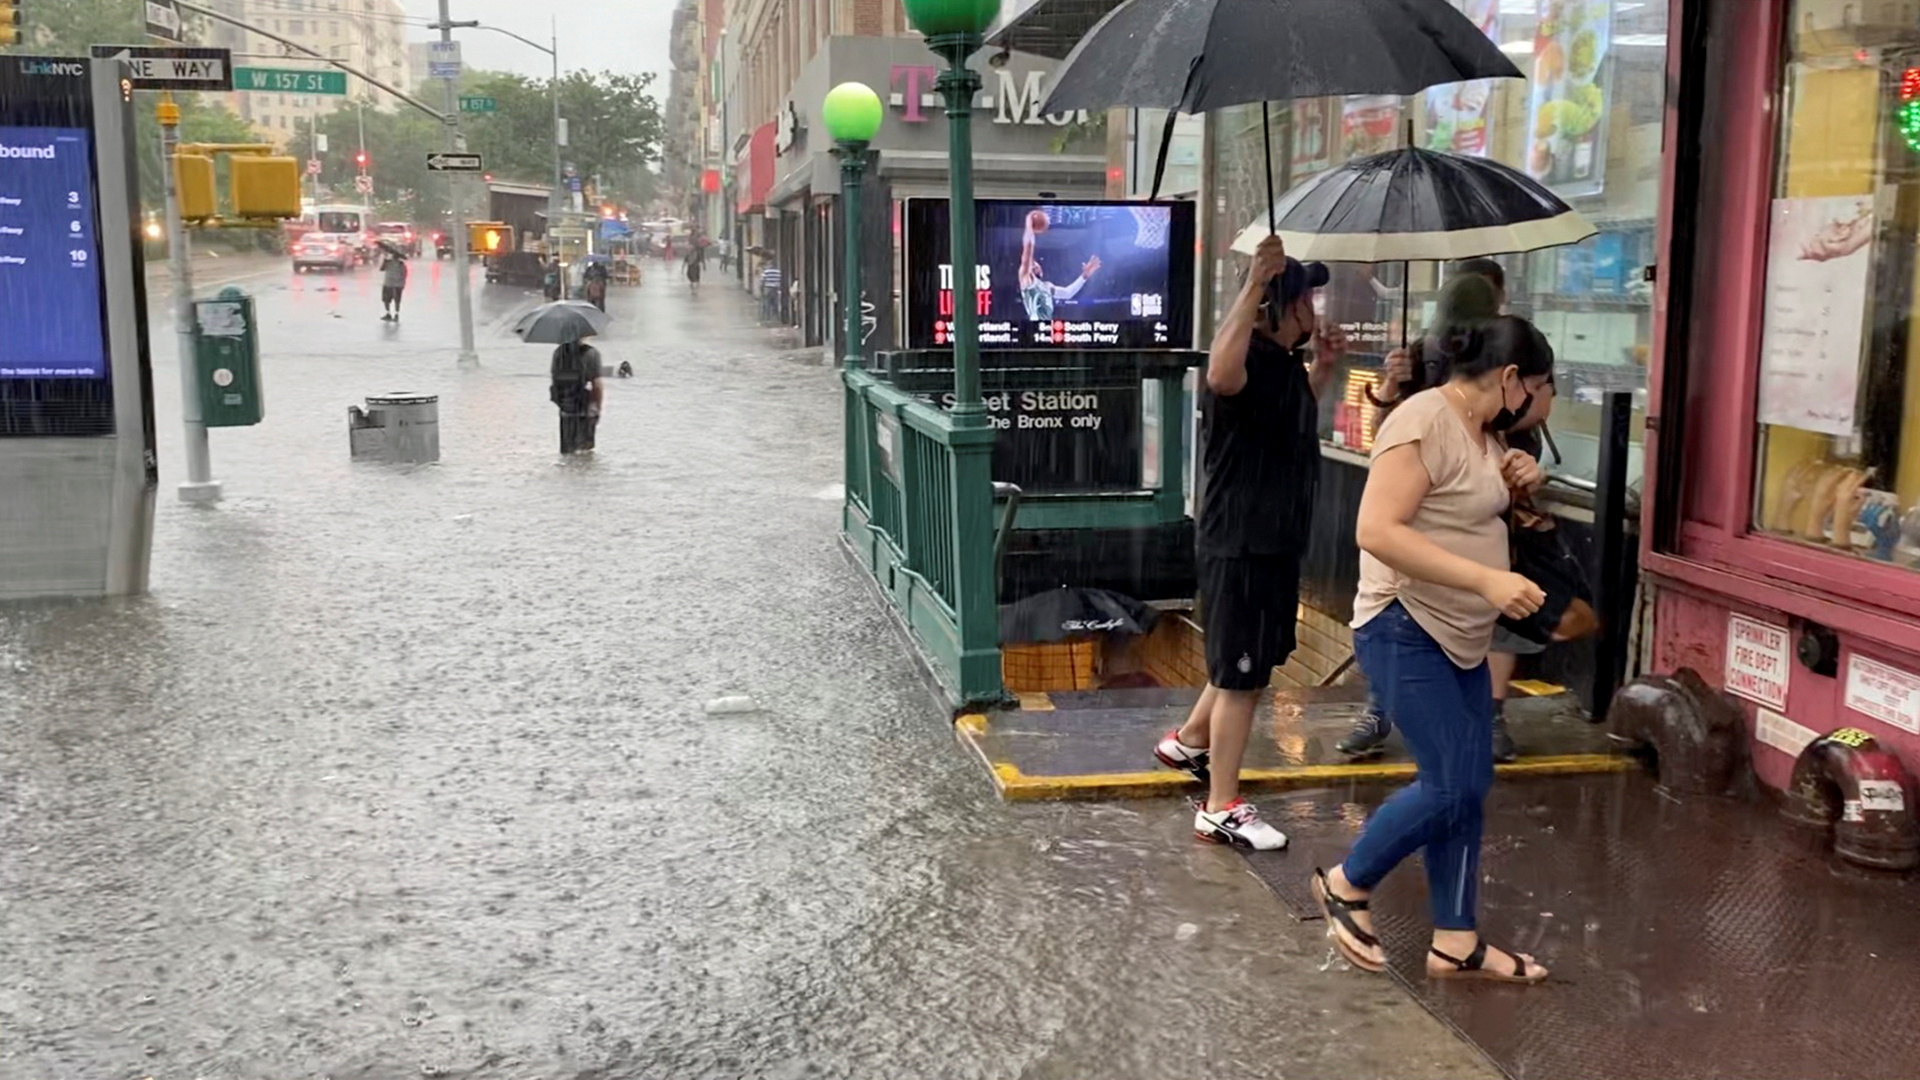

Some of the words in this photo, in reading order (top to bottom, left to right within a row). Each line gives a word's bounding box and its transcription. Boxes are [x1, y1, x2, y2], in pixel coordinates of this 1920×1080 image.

[20, 60, 83, 76] LinkNYC
[129, 60, 153, 77] NE
[171, 61, 213, 77] WAY
[251, 71, 267, 88] W
[275, 73, 300, 89] 157
[307, 74, 324, 90] St
[68, 191, 79, 203] 3
[70, 220, 81, 232] 6
[69, 249, 87, 261] 10
[1064, 321, 1092, 332] South
[1093, 322, 1119, 333] Ferry
[1064, 333, 1092, 342] South
[1093, 333, 1119, 344] Ferry
[941, 392, 1011, 411] Set
[1021, 391, 1098, 411] Station
[1017, 414, 1063, 429] Bronx
[1070, 413, 1102, 430] only
[1735, 645, 1754, 668] FIRE
[1730, 667, 1783, 701] CONNECTION
